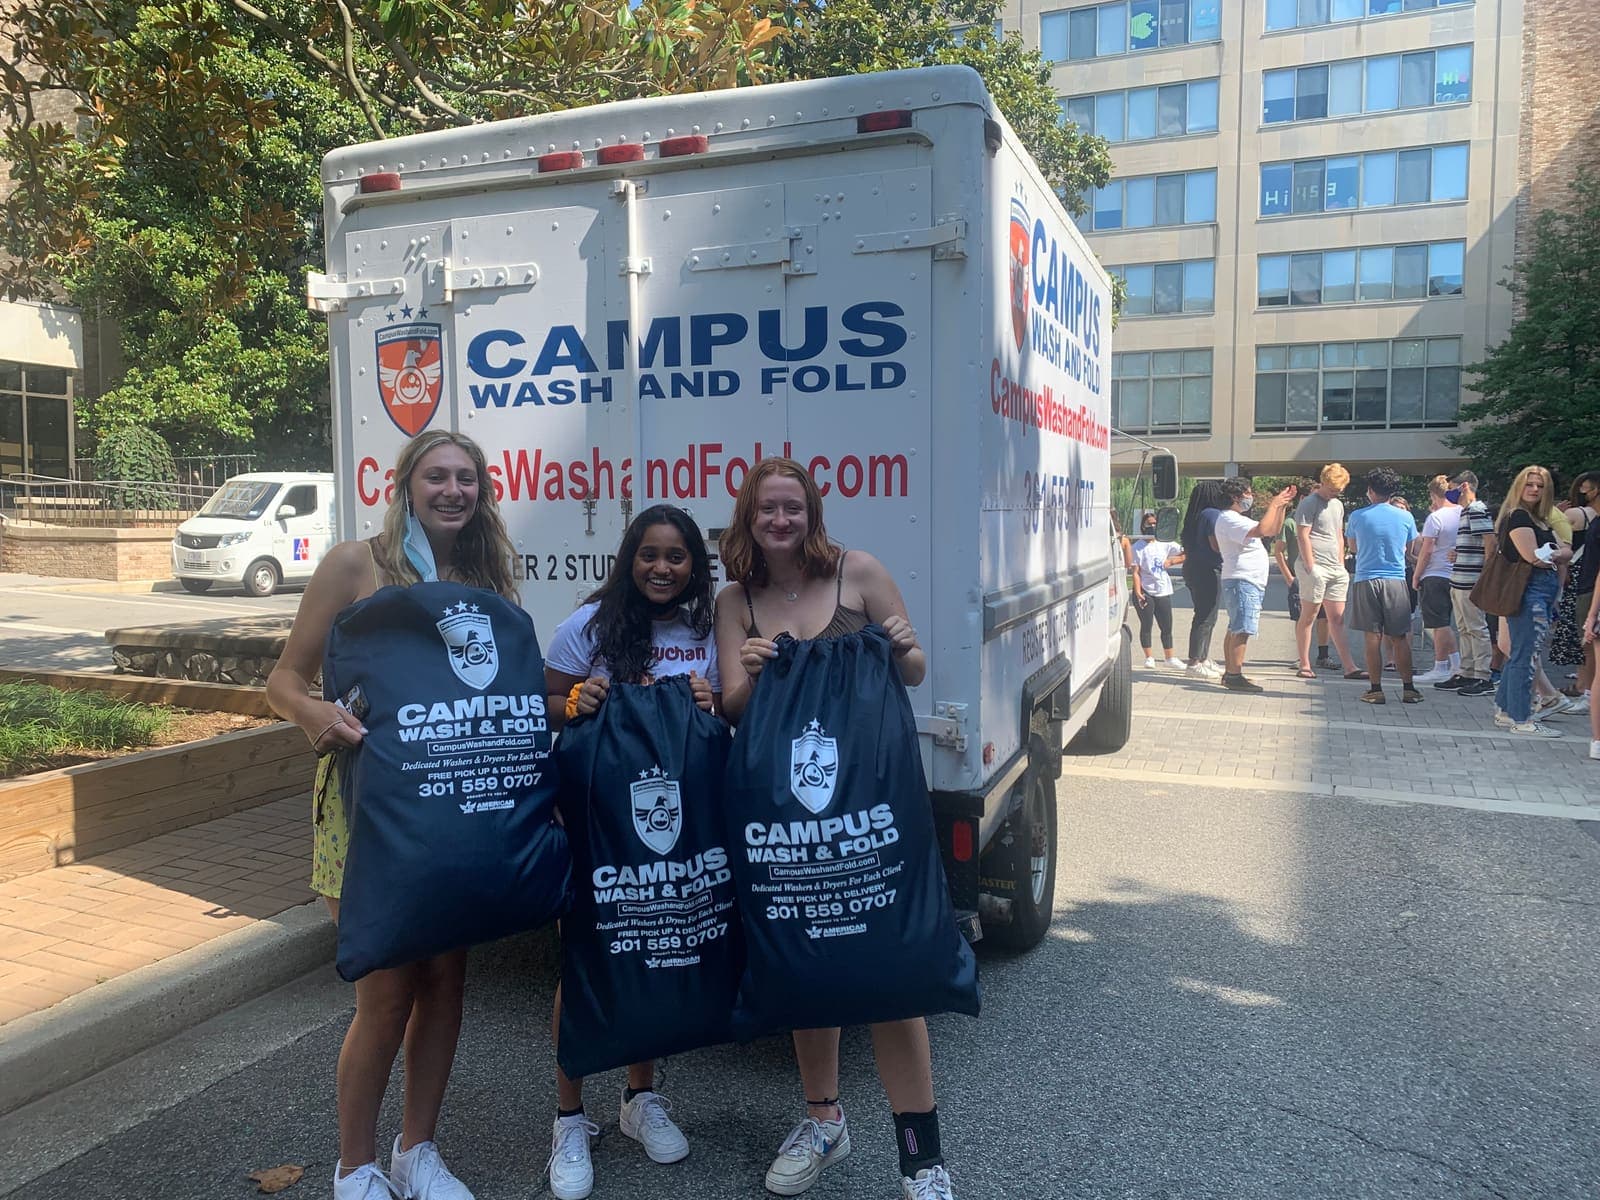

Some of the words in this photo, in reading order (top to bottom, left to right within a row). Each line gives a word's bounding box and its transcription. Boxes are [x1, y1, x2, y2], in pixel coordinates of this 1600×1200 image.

[1265, 190, 1289, 206] Hi
[1031, 218, 1100, 357] CAMPUS
[465, 301, 908, 379] CAMPUS
[1031, 307, 1061, 369] WASH
[1064, 338, 1081, 382] AND
[1084, 354, 1100, 395] FOLD
[469, 376, 612, 409] WASH
[639, 369, 741, 400] AND
[760, 361, 907, 395] FOLD
[990, 358, 1108, 450] CampusWashandFold.com
[546, 554, 558, 581] 2
[651, 645, 706, 662] uchan
[397, 694, 546, 726] CAMPUS
[399, 721, 472, 742] WASH
[479, 719, 496, 735] &
[502, 718, 547, 734] FOLD
[432, 737, 532, 752] CampusWashandFold.com
[401, 760, 440, 771] Dedicated
[443, 757, 473, 768] Washers
[483, 754, 506, 765] Dryers
[506, 753, 519, 761] For
[519, 751, 534, 760] Each
[427, 772, 452, 780] FREE
[454, 769, 476, 778] PICK
[477, 768, 490, 776] UP
[501, 764, 537, 774] DELIVERY
[418, 781, 455, 797] 301
[462, 776, 498, 793] 559
[503, 772, 542, 789] 0707
[744, 803, 894, 846] CAMPUS
[747, 847, 808, 863] WASH
[815, 845, 833, 861] &
[839, 827, 899, 857] FOLD
[592, 846, 728, 889] CAMPUS
[773, 857, 876, 876] CampusWashandFold.com
[593, 886, 655, 904] WASH
[661, 884, 678, 898] &
[681, 868, 731, 899] FOLD
[772, 895, 795, 904] FREE
[796, 895, 817, 903] PICK
[819, 893, 832, 901] UP
[843, 882, 886, 899] DELIVERY
[784, 883, 813, 892] Washers
[822, 879, 847, 890] Dryers
[849, 877, 862, 886] For
[863, 872, 881, 883] Each
[766, 905, 799, 920] 301
[805, 902, 844, 918] 559
[849, 889, 897, 913] 0707
[609, 939, 641, 954] 301
[647, 936, 681, 950] 559
[686, 922, 728, 947] 0707
[617, 930, 639, 938] FREE
[640, 929, 660, 937] PICK
[661, 927, 674, 935] UP
[682, 916, 718, 935] DELIVERY
